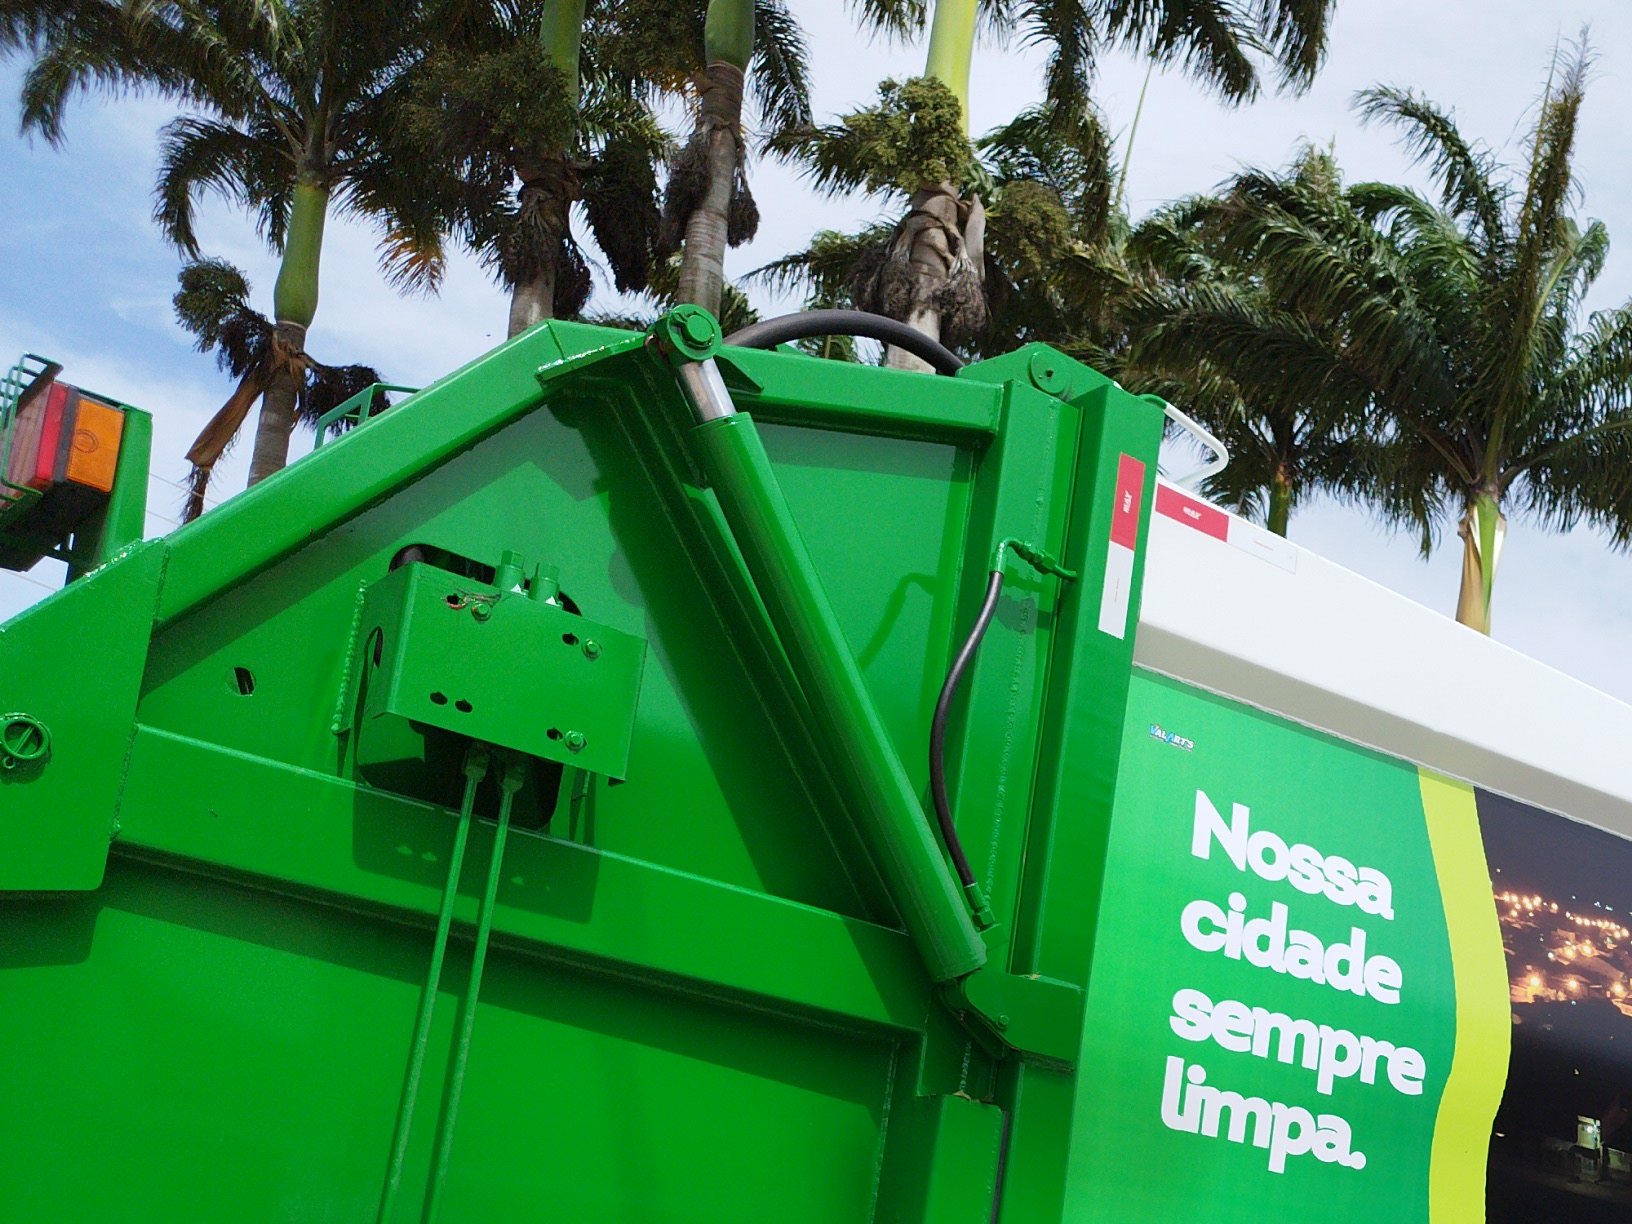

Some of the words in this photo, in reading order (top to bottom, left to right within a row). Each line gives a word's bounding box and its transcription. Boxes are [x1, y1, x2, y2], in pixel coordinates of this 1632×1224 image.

[1192, 790, 1394, 920] Nossa
[1181, 892, 1402, 1004] cidade
[1169, 989, 1426, 1095] sempre
[1161, 1055, 1367, 1174] limpa.
